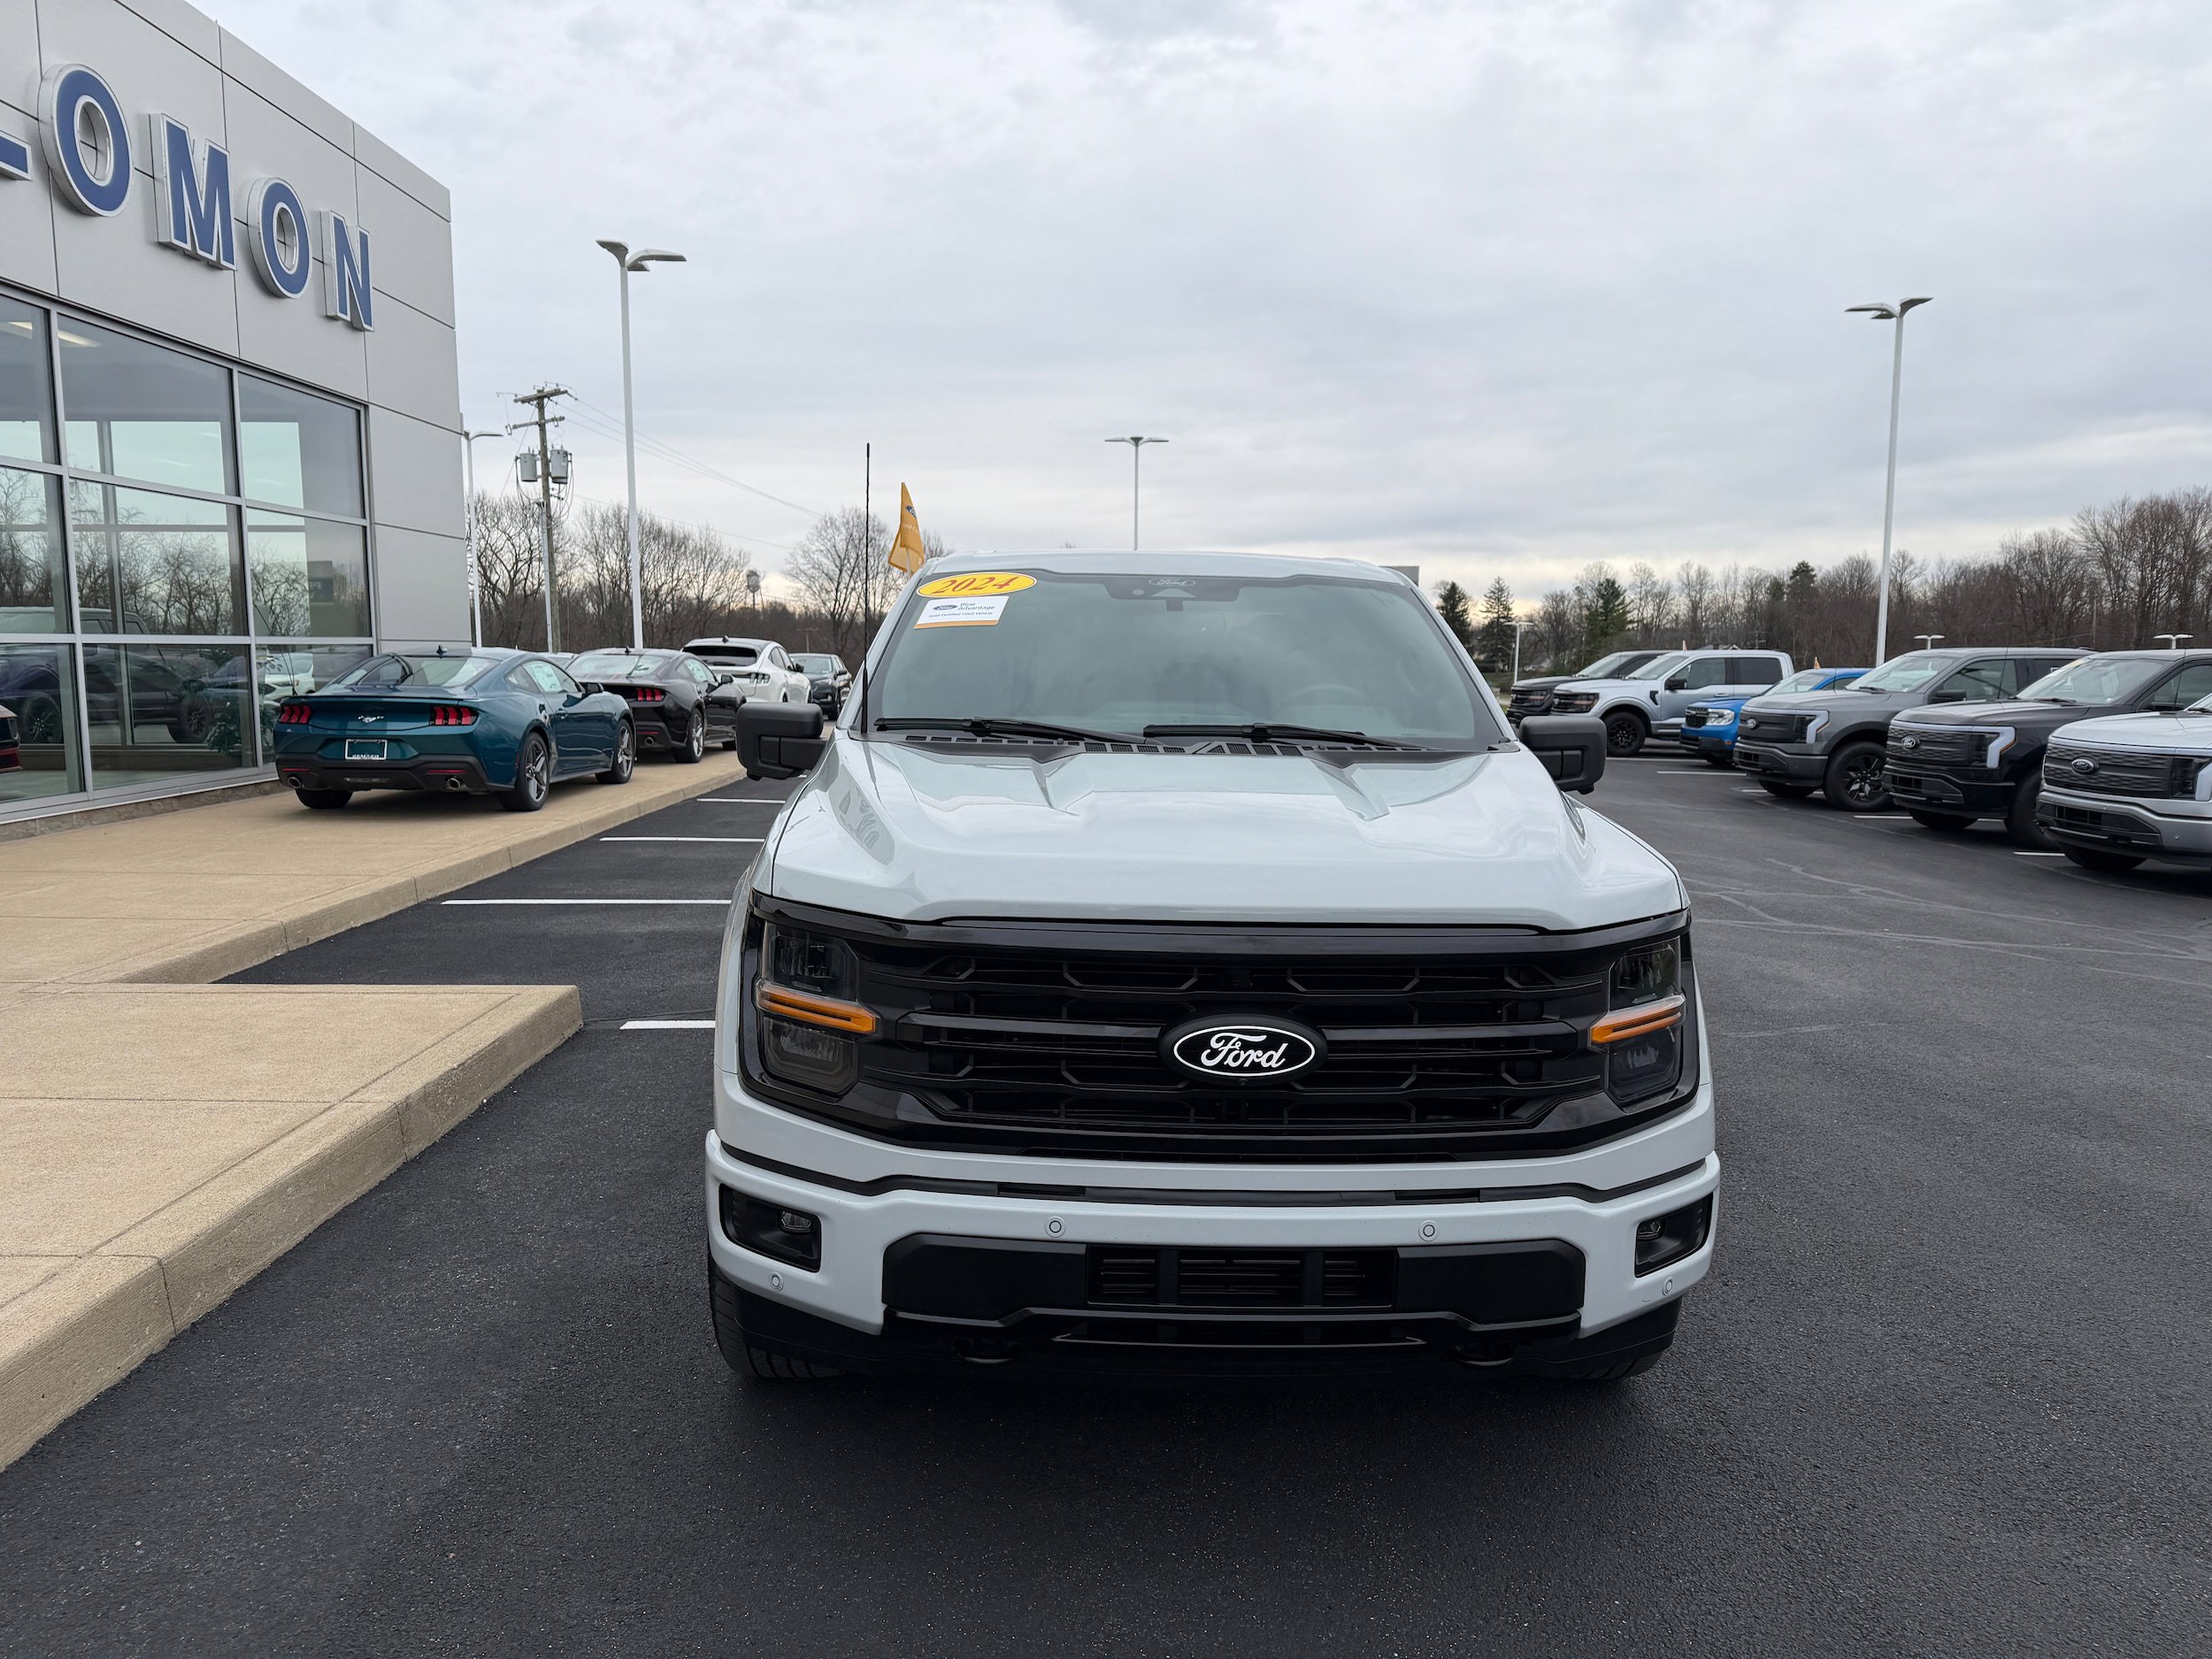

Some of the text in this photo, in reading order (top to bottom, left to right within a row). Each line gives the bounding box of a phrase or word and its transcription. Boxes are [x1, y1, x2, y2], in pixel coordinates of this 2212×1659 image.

[0, 63, 374, 333] OMON
[931, 576, 1019, 594] 2024
[1201, 1032, 1289, 1068] Ford
